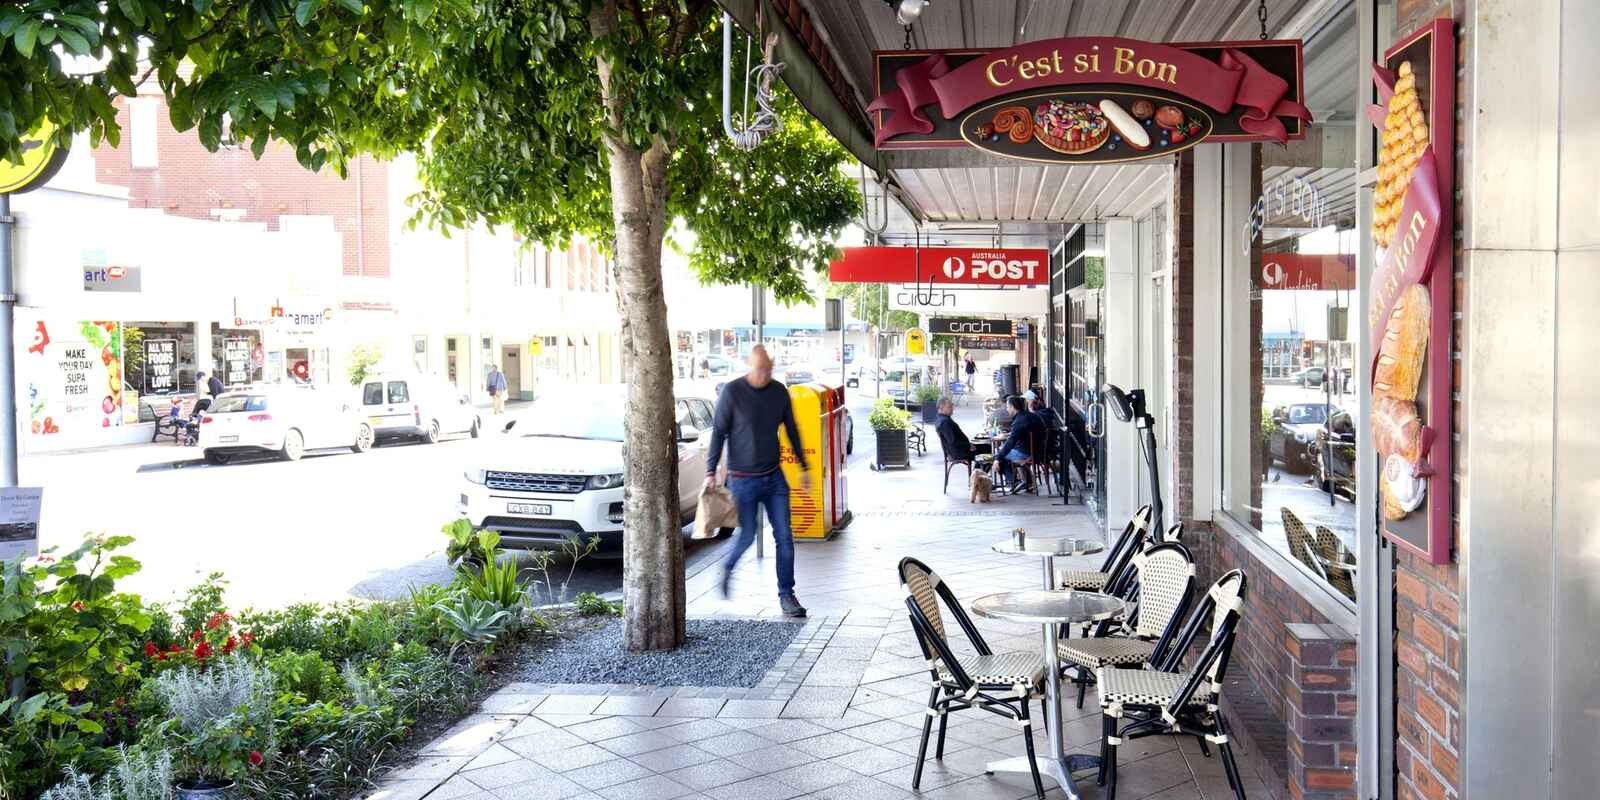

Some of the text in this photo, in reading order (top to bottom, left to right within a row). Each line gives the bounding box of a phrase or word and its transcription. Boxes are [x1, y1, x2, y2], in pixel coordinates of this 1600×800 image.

[985, 45, 1177, 87] C'est si Bon
[972, 252, 1007, 260] AUSTRALIA
[971, 260, 1039, 279] POST
[897, 289, 956, 307] cinch
[949, 320, 991, 333] cinch
[65, 348, 86, 359] MAKE
[148, 343, 173, 353] ALL THE
[148, 353, 173, 365] FOODS
[58, 361, 93, 371] YOUR DAY
[153, 365, 170, 377] YOU
[66, 372, 86, 383] SUPA
[151, 376, 172, 388] LOVE
[65, 385, 88, 395] FRESH
